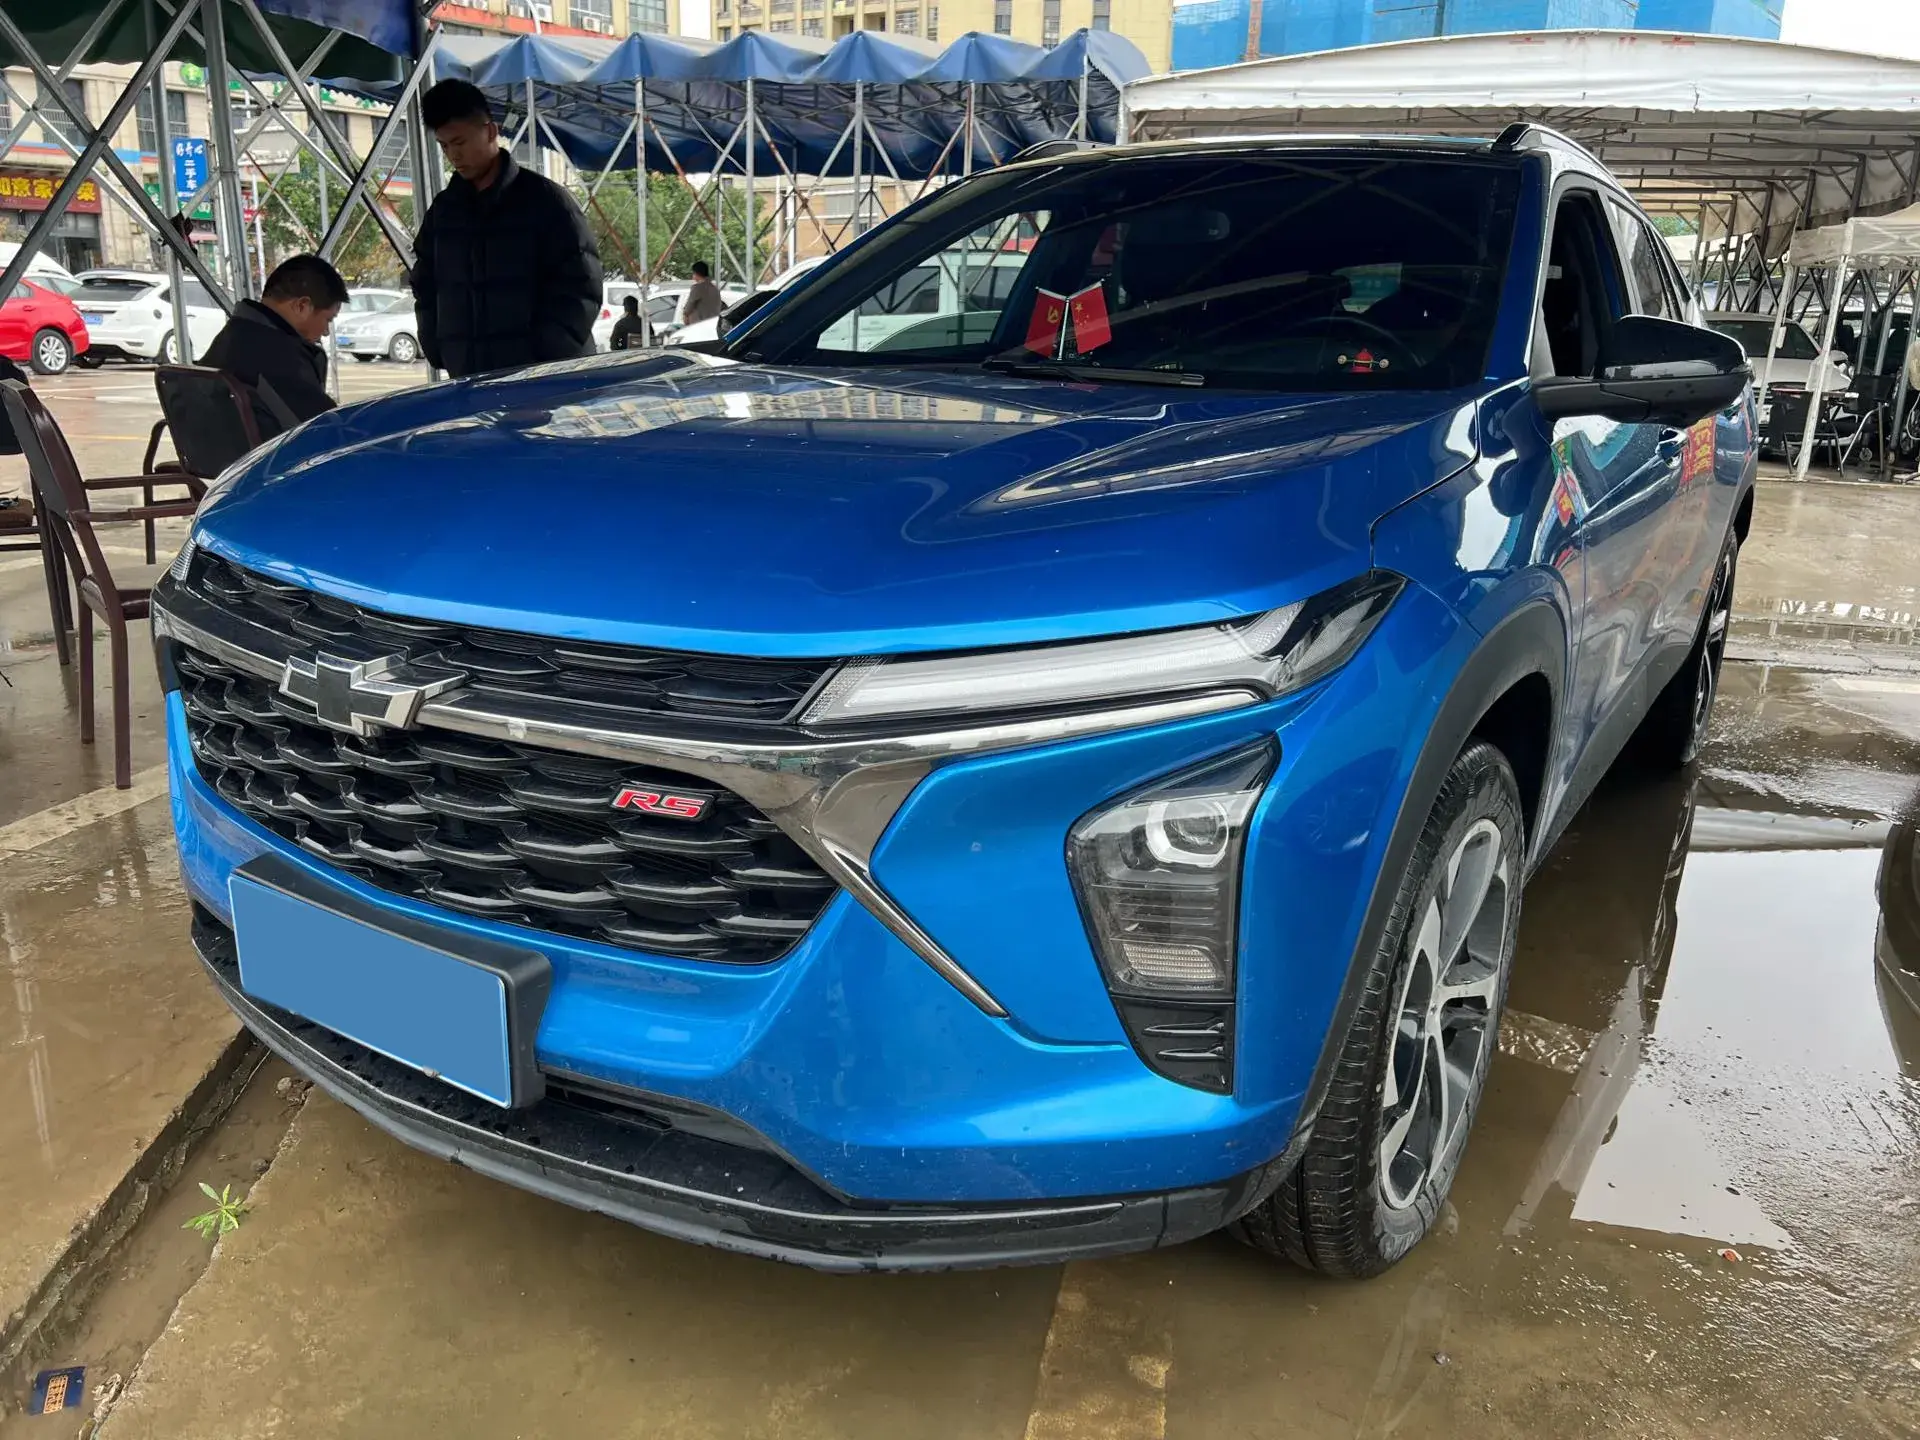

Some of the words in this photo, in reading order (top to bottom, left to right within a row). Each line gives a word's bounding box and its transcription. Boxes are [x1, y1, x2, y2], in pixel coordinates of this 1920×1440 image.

[0, 177, 96, 201] 如意家菜
[613, 788, 705, 818] RS
